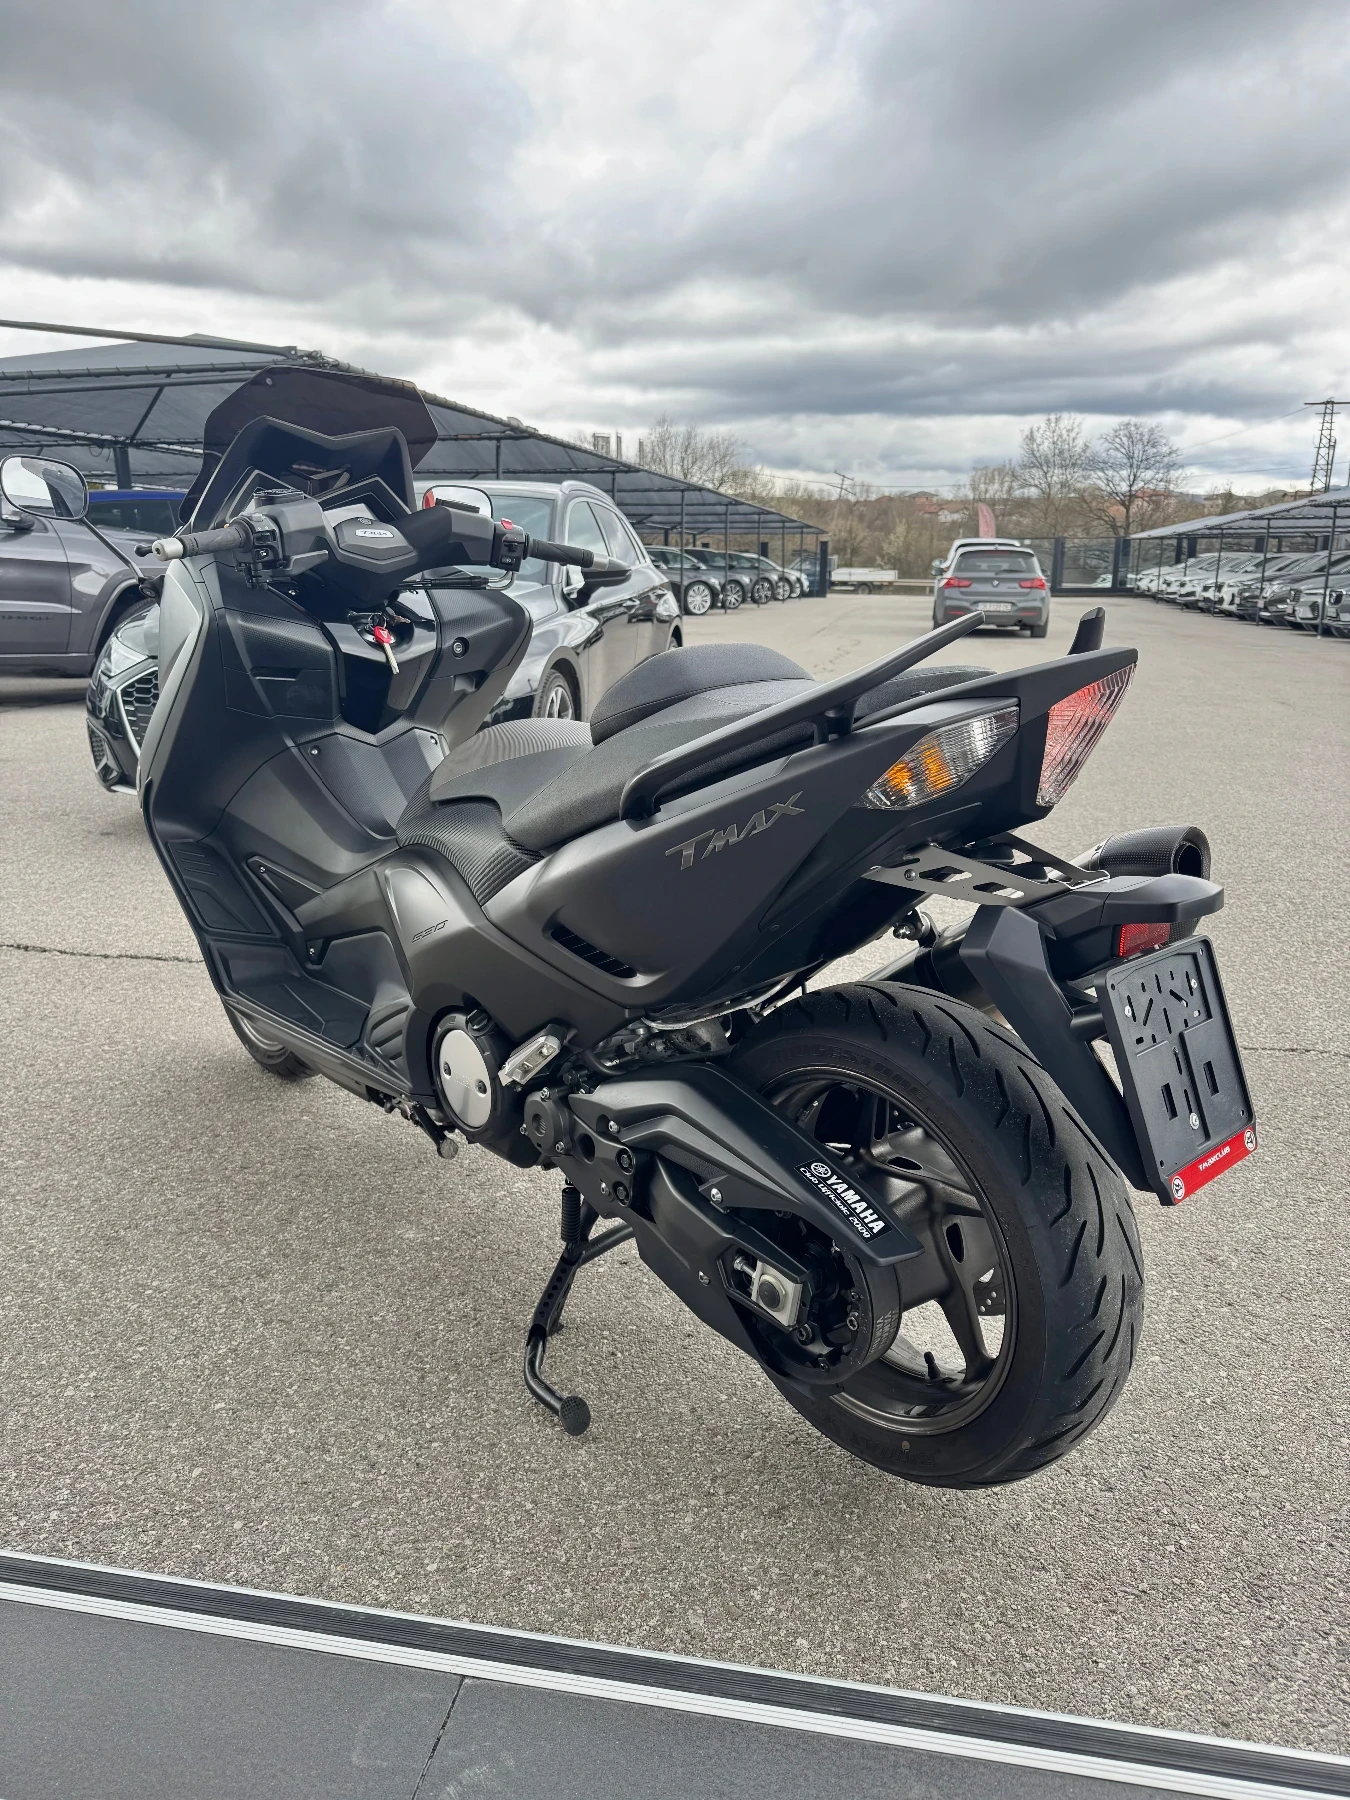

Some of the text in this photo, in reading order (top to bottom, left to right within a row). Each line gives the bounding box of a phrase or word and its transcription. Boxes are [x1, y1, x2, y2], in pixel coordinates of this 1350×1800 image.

[664, 790, 806, 871] TMAX
[411, 919, 449, 944] 530
[825, 1174, 886, 1234] YAMAHA
